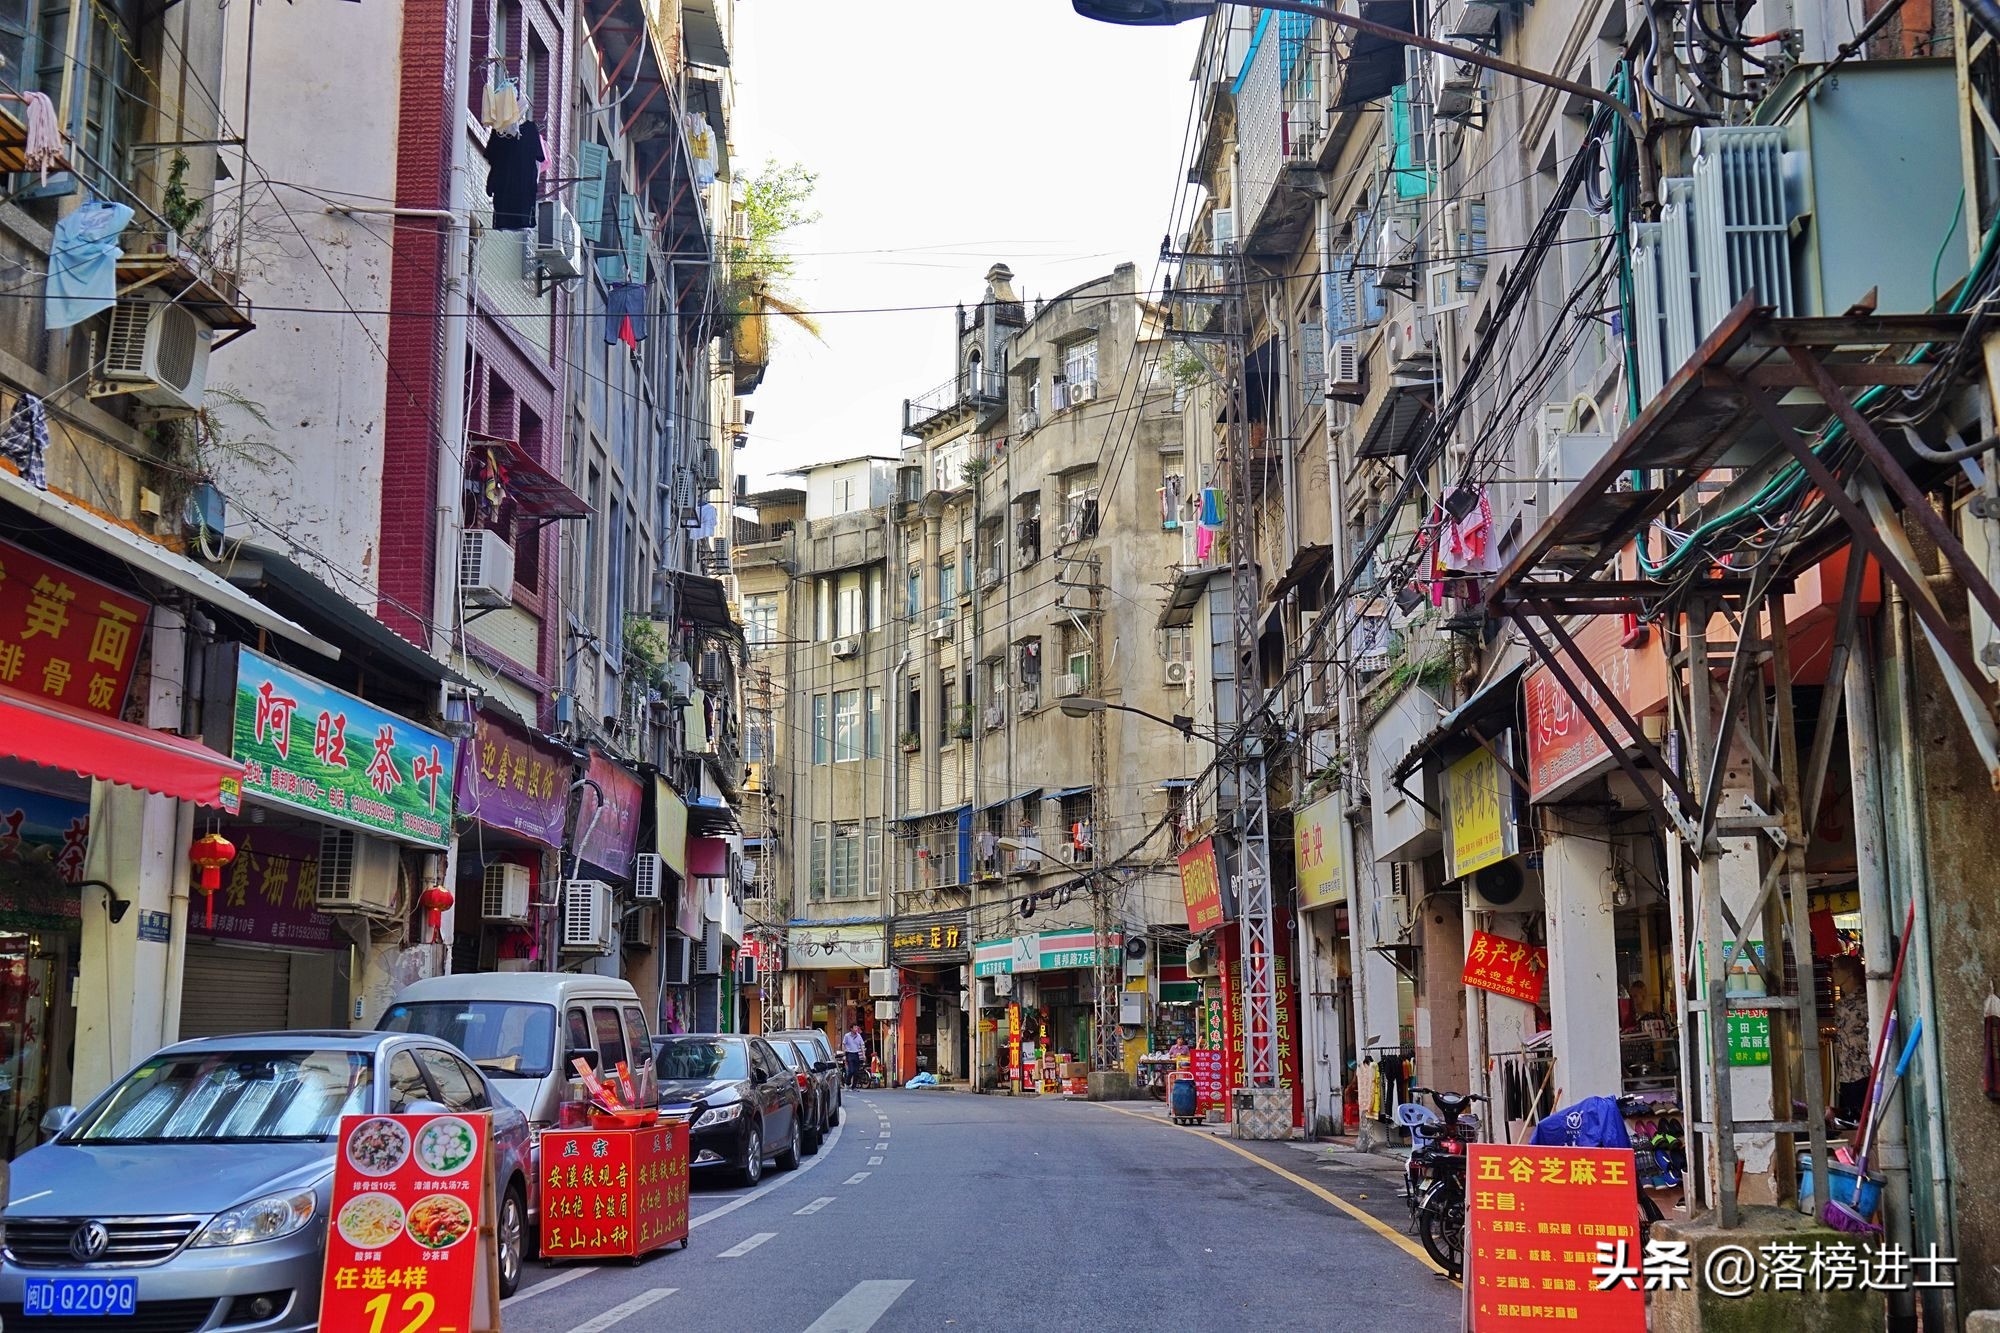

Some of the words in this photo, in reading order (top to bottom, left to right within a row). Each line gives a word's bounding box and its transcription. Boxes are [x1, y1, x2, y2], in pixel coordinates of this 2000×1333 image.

[0, 559, 138, 672] 笋面
[0, 640, 118, 711] 排骨饭
[255, 680, 443, 815] 阿旺茶叶
[1470, 935, 1546, 977] 房产中介
[1463, 975, 1516, 995] 18059232599
[1474, 967, 1531, 990] 欢迎委托
[1009, 1005, 1020, 1068] 超市
[563, 1139, 609, 1157] 正宗
[548, 1162, 629, 1189] 安溪铁观音
[638, 1155, 687, 1186] 安溪铁观音
[1477, 1156, 1628, 1186] 五谷芝麻王
[353, 1181, 397, 1191] 排骨饭10元
[548, 1193, 584, 1219] 大红袍
[592, 1192, 628, 1220] 金骏眉
[549, 1226, 629, 1250] 正山小种
[639, 1210, 686, 1245] 正山小种
[422, 1251, 449, 1261] 沙茶面
[334, 1266, 428, 1290] 任选4样
[364, 1291, 457, 1333] 12
